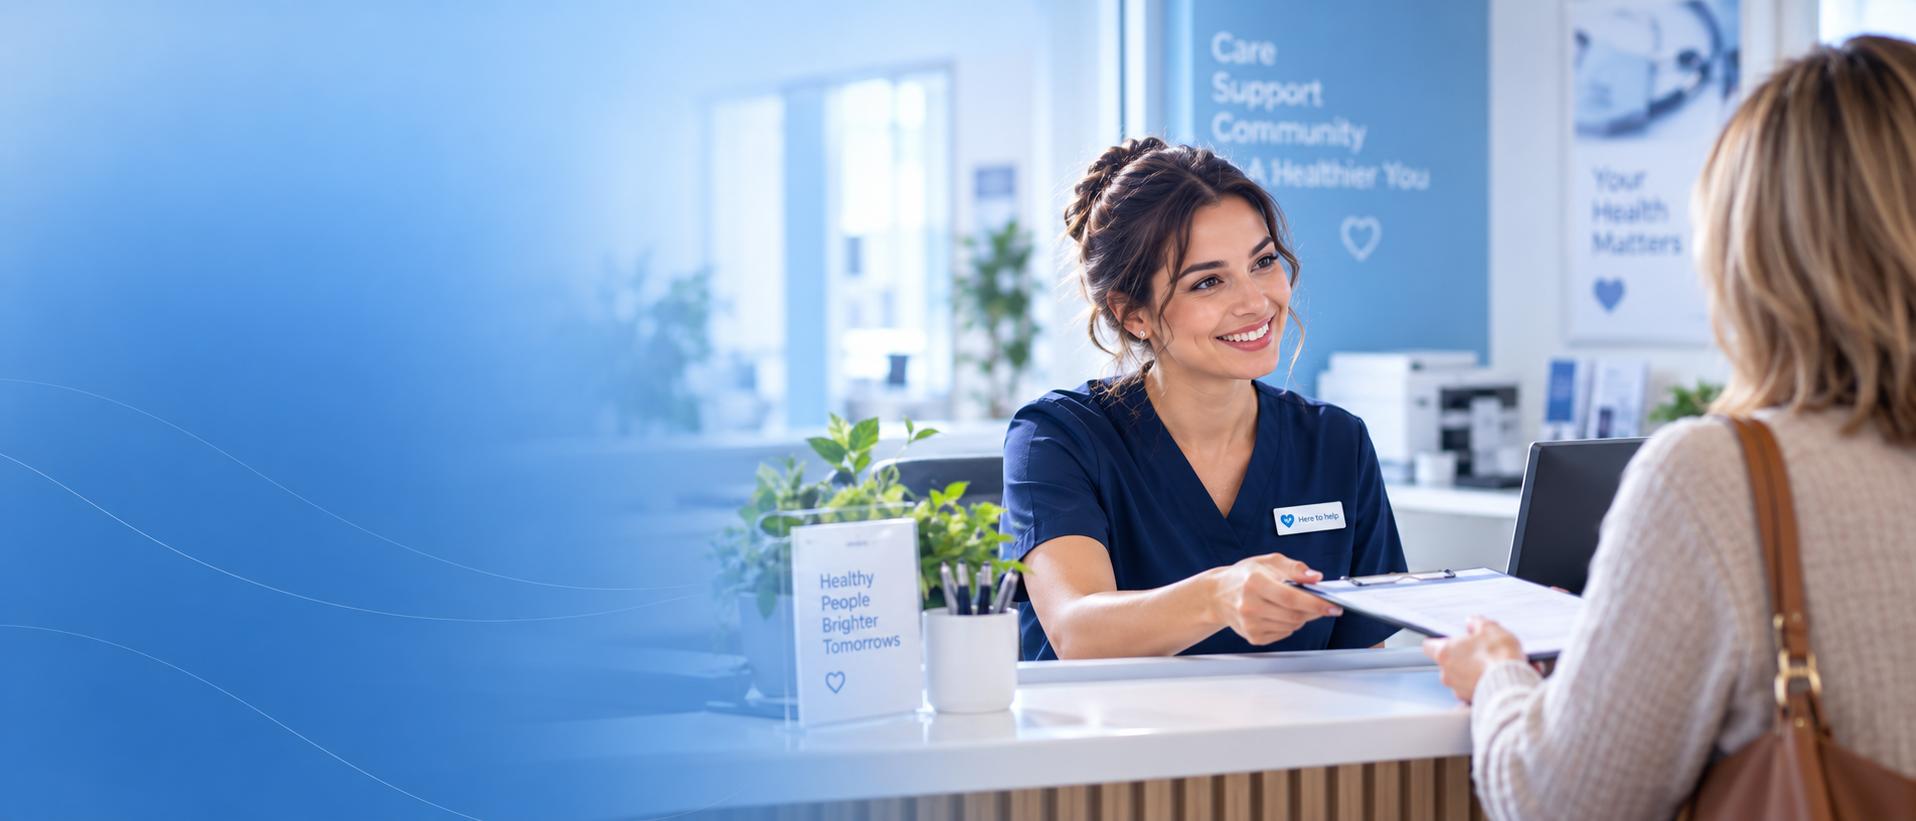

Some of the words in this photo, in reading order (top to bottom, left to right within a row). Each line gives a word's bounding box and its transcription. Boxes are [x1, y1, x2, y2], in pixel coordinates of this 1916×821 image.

[1211, 31, 1277, 66] Care
[1212, 71, 1323, 109] Support
[1211, 112, 1367, 154] Community
[1249, 157, 1268, 184] A
[1271, 158, 1380, 190] Healthier
[1382, 162, 1430, 190] You
[1592, 168, 1646, 193] Your
[1592, 199, 1669, 224] Health
[1592, 231, 1683, 256] Matters
[1298, 515, 1315, 523] Here
[1324, 512, 1339, 521] help
[820, 570, 874, 590] Healthy
[821, 592, 870, 612] People
[822, 614, 878, 635] Brighter
[823, 635, 901, 655] Tomorrows
